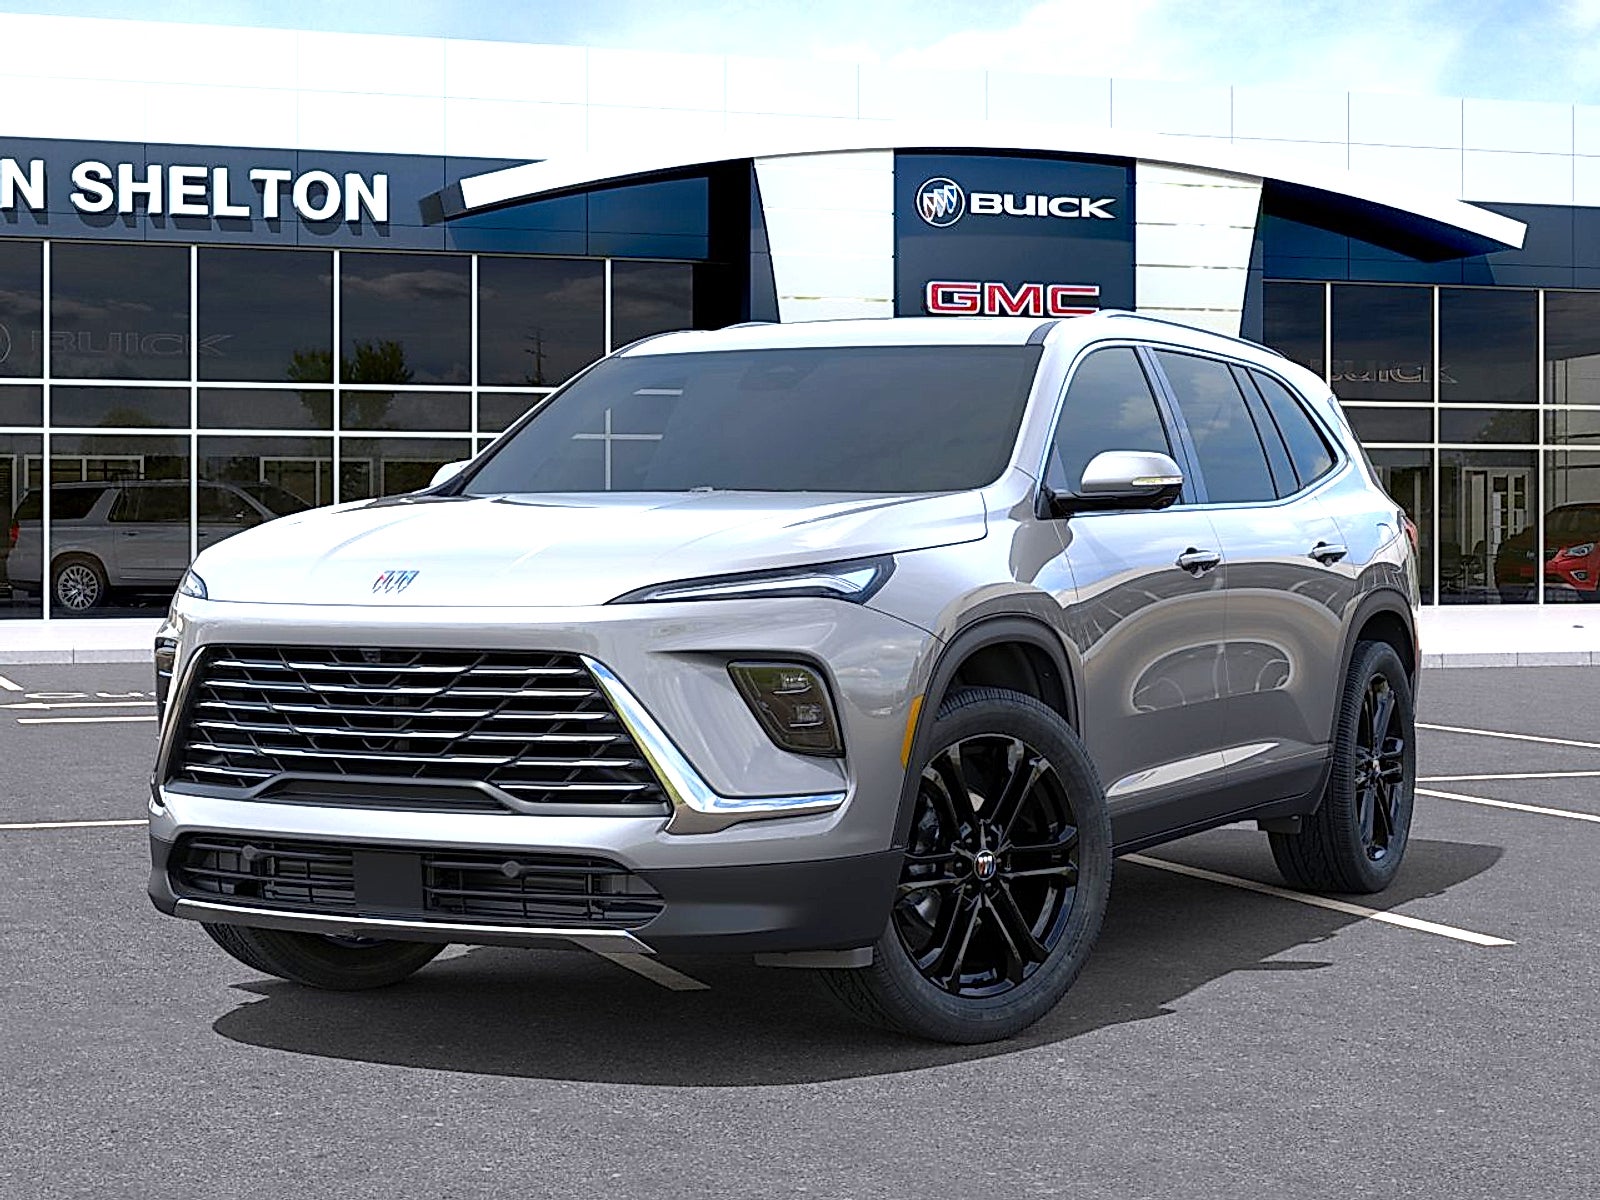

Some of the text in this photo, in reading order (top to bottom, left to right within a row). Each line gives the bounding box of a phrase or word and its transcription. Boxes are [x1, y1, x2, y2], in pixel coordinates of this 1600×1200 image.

[0, 158, 389, 223] N SHELTON
[970, 192, 1118, 219] BUICK
[926, 280, 1100, 317] GMC
[31, 330, 235, 357] BUICK
